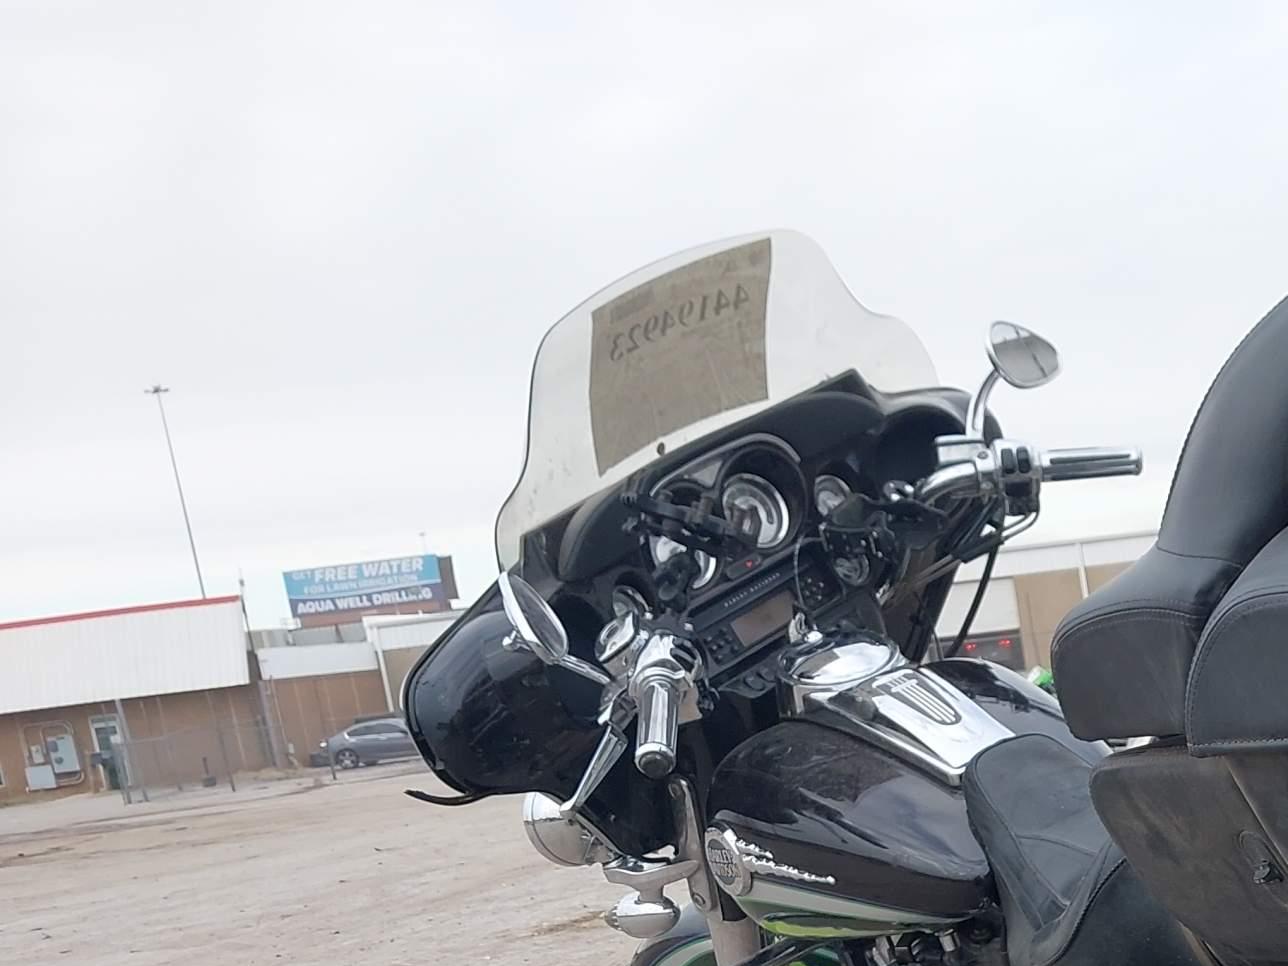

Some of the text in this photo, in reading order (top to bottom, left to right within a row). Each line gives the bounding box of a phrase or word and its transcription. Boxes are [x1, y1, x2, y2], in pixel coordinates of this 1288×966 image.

[314, 566, 358, 583] FREE
[362, 558, 423, 577] WATER
[297, 601, 335, 614] AQUA
[336, 595, 371, 609] WELL
